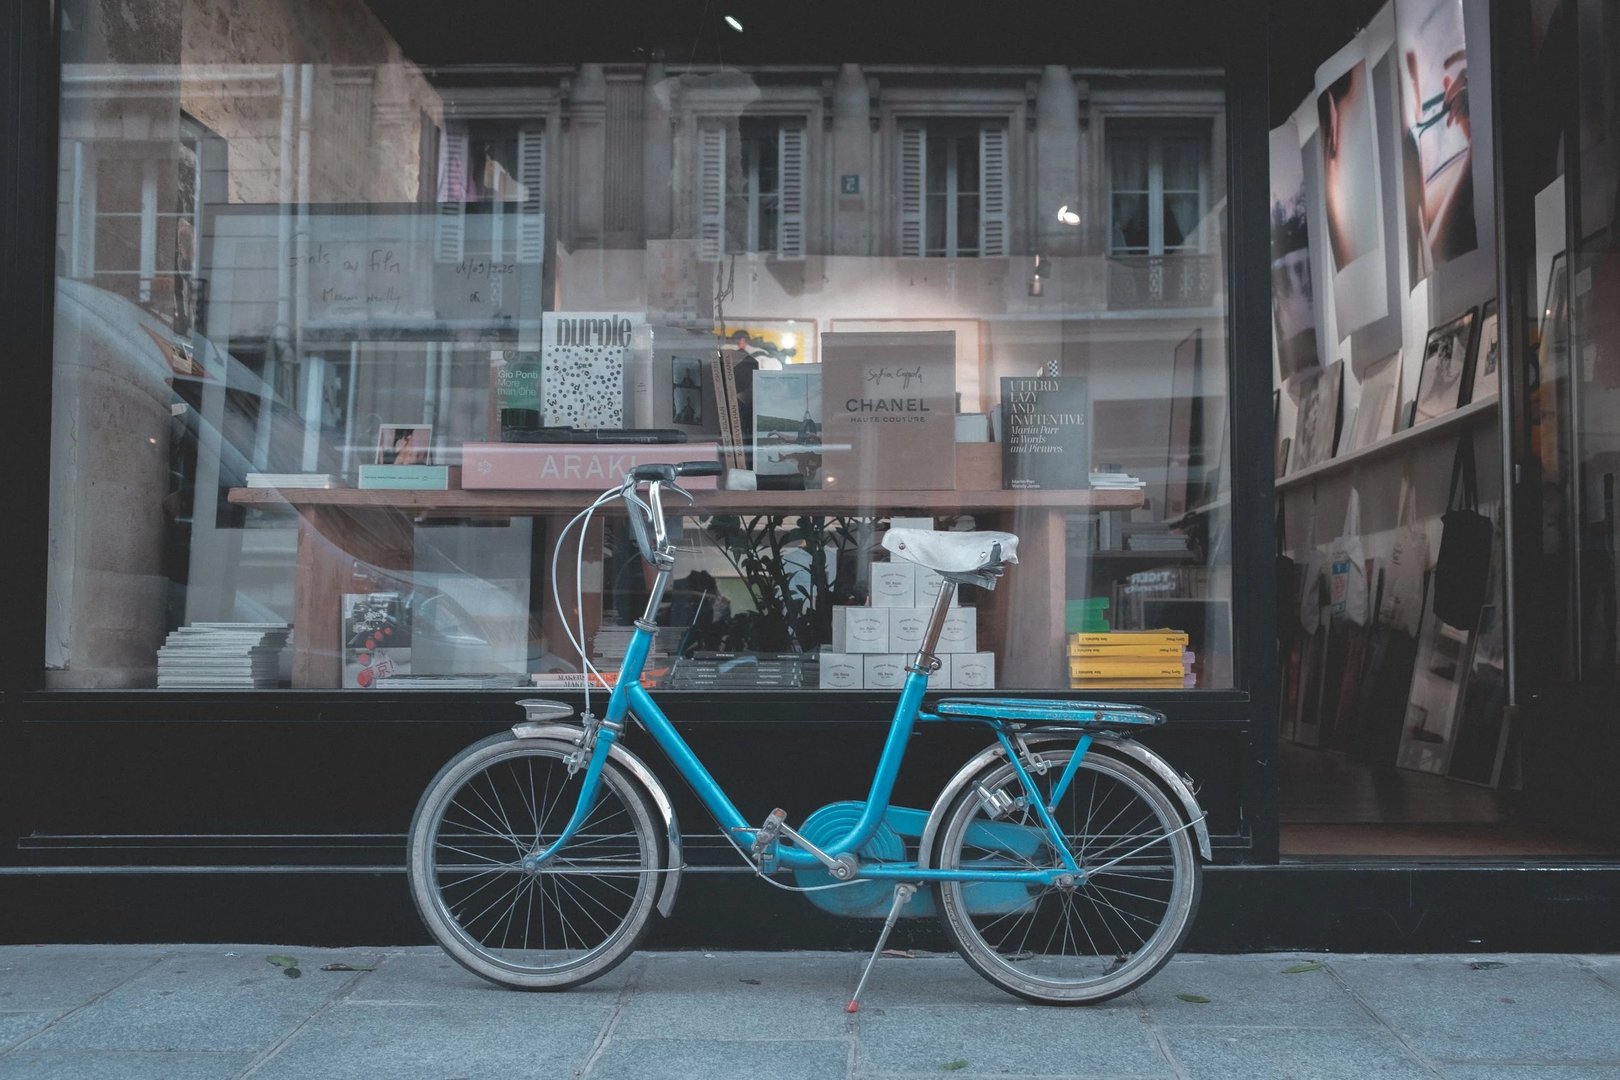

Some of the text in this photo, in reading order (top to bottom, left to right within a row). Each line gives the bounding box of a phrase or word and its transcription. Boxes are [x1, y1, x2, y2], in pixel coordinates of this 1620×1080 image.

[499, 370, 538, 379] Gio Ponti
[1010, 380, 1059, 391] UTTERLY
[498, 387, 516, 396] than
[1010, 391, 1037, 402] LAZY
[845, 398, 930, 412] CHANEL
[1010, 403, 1035, 413] AND
[1011, 414, 1085, 425] INATTENTIVE
[1011, 425, 1060, 434] Martin Parr
[1010, 434, 1046, 444] in Words
[1010, 443, 1063, 453] and Pictures
